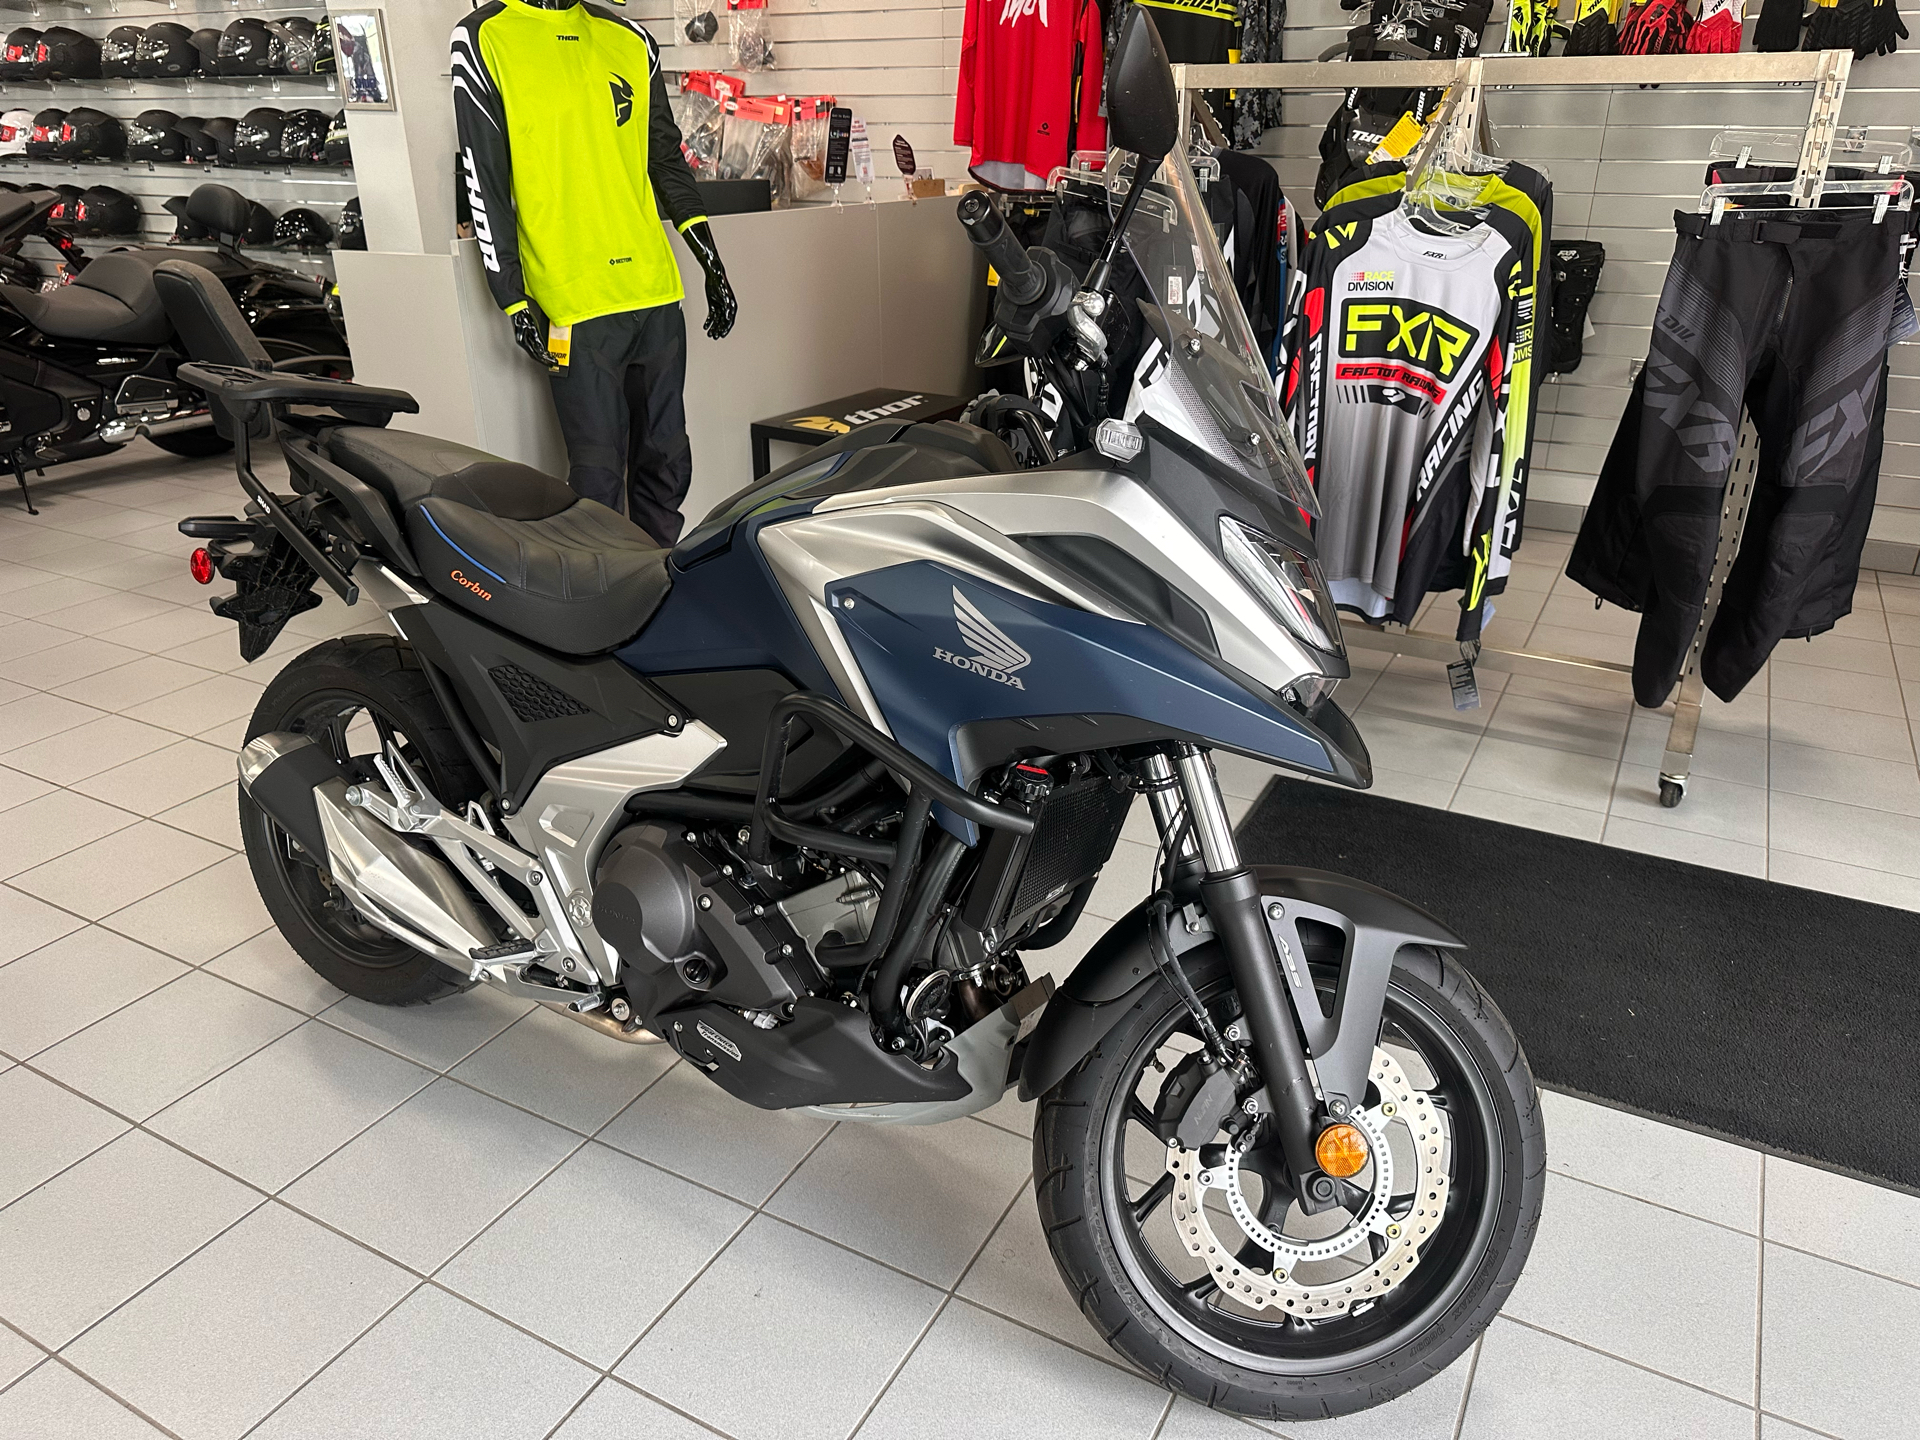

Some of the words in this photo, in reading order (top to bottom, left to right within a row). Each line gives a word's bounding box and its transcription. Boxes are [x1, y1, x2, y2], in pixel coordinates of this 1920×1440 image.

[1415, 92, 1427, 121] THOR
[1352, 130, 1387, 145] THO
[462, 146, 501, 273] THOR
[1348, 281, 1394, 291] DIVISION
[1365, 271, 1395, 281] RACE
[1346, 305, 1471, 376] FXR
[844, 394, 924, 425] thor
[1416, 370, 1484, 502] RACING
[450, 570, 492, 601] Corbin
[932, 646, 1026, 691] HONDA
[1278, 934, 1303, 988] ABS
[701, 1030, 740, 1058] Transmission
[714, 1033, 733, 1049] Clutch
